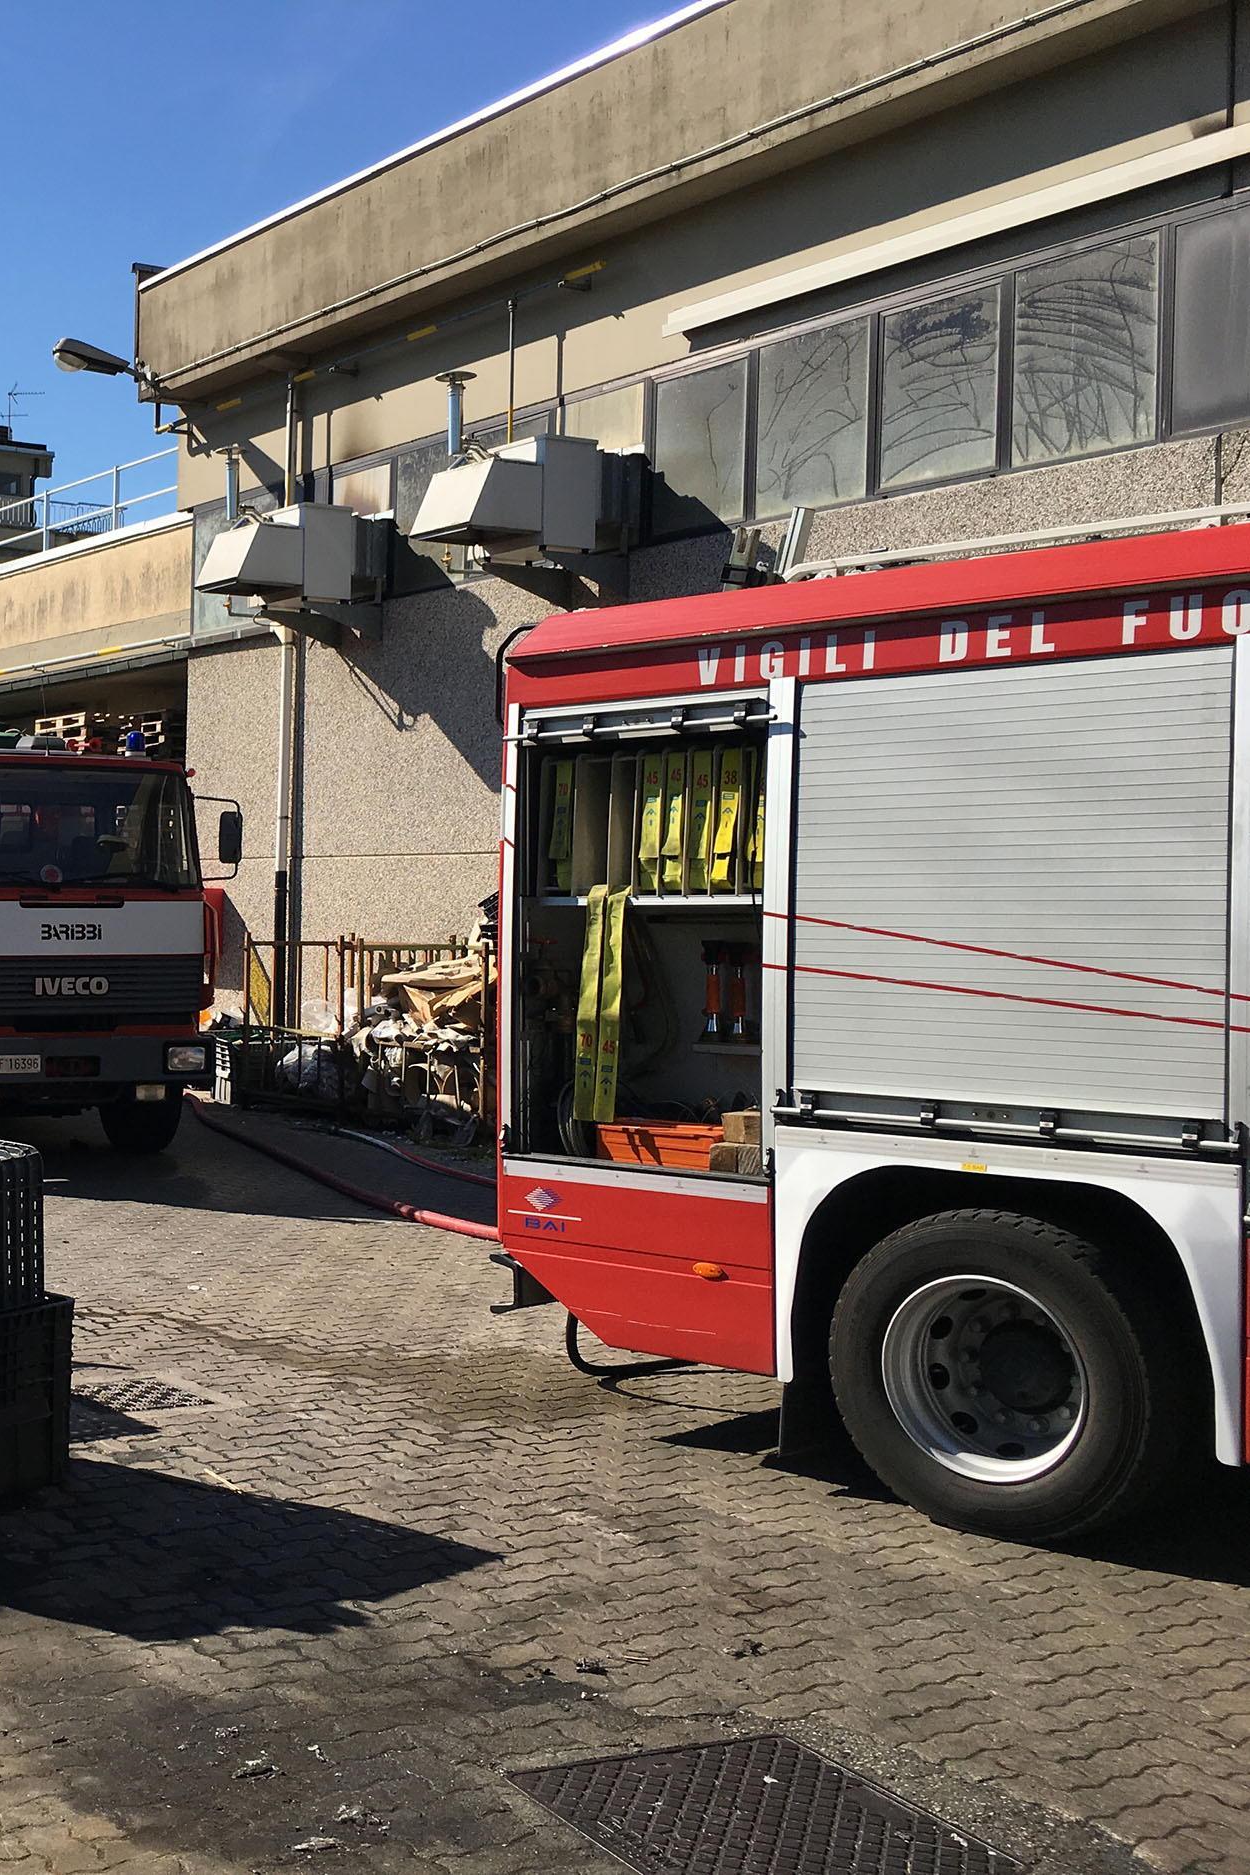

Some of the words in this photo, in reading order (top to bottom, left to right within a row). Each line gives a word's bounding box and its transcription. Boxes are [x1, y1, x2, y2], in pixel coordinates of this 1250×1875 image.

[697, 630, 877, 686] VIGILI
[938, 610, 1056, 663] DEL
[647, 771, 659, 785] 45
[671, 769, 682, 782] 45
[697, 774, 709, 788] 45
[724, 770, 738, 785] 38
[35, 976, 109, 996] IVECO
[580, 1032, 593, 1048] 70
[602, 1039, 615, 1054] 45
[9, 1058, 39, 1070] 16396
[525, 1217, 565, 1233] BAI
